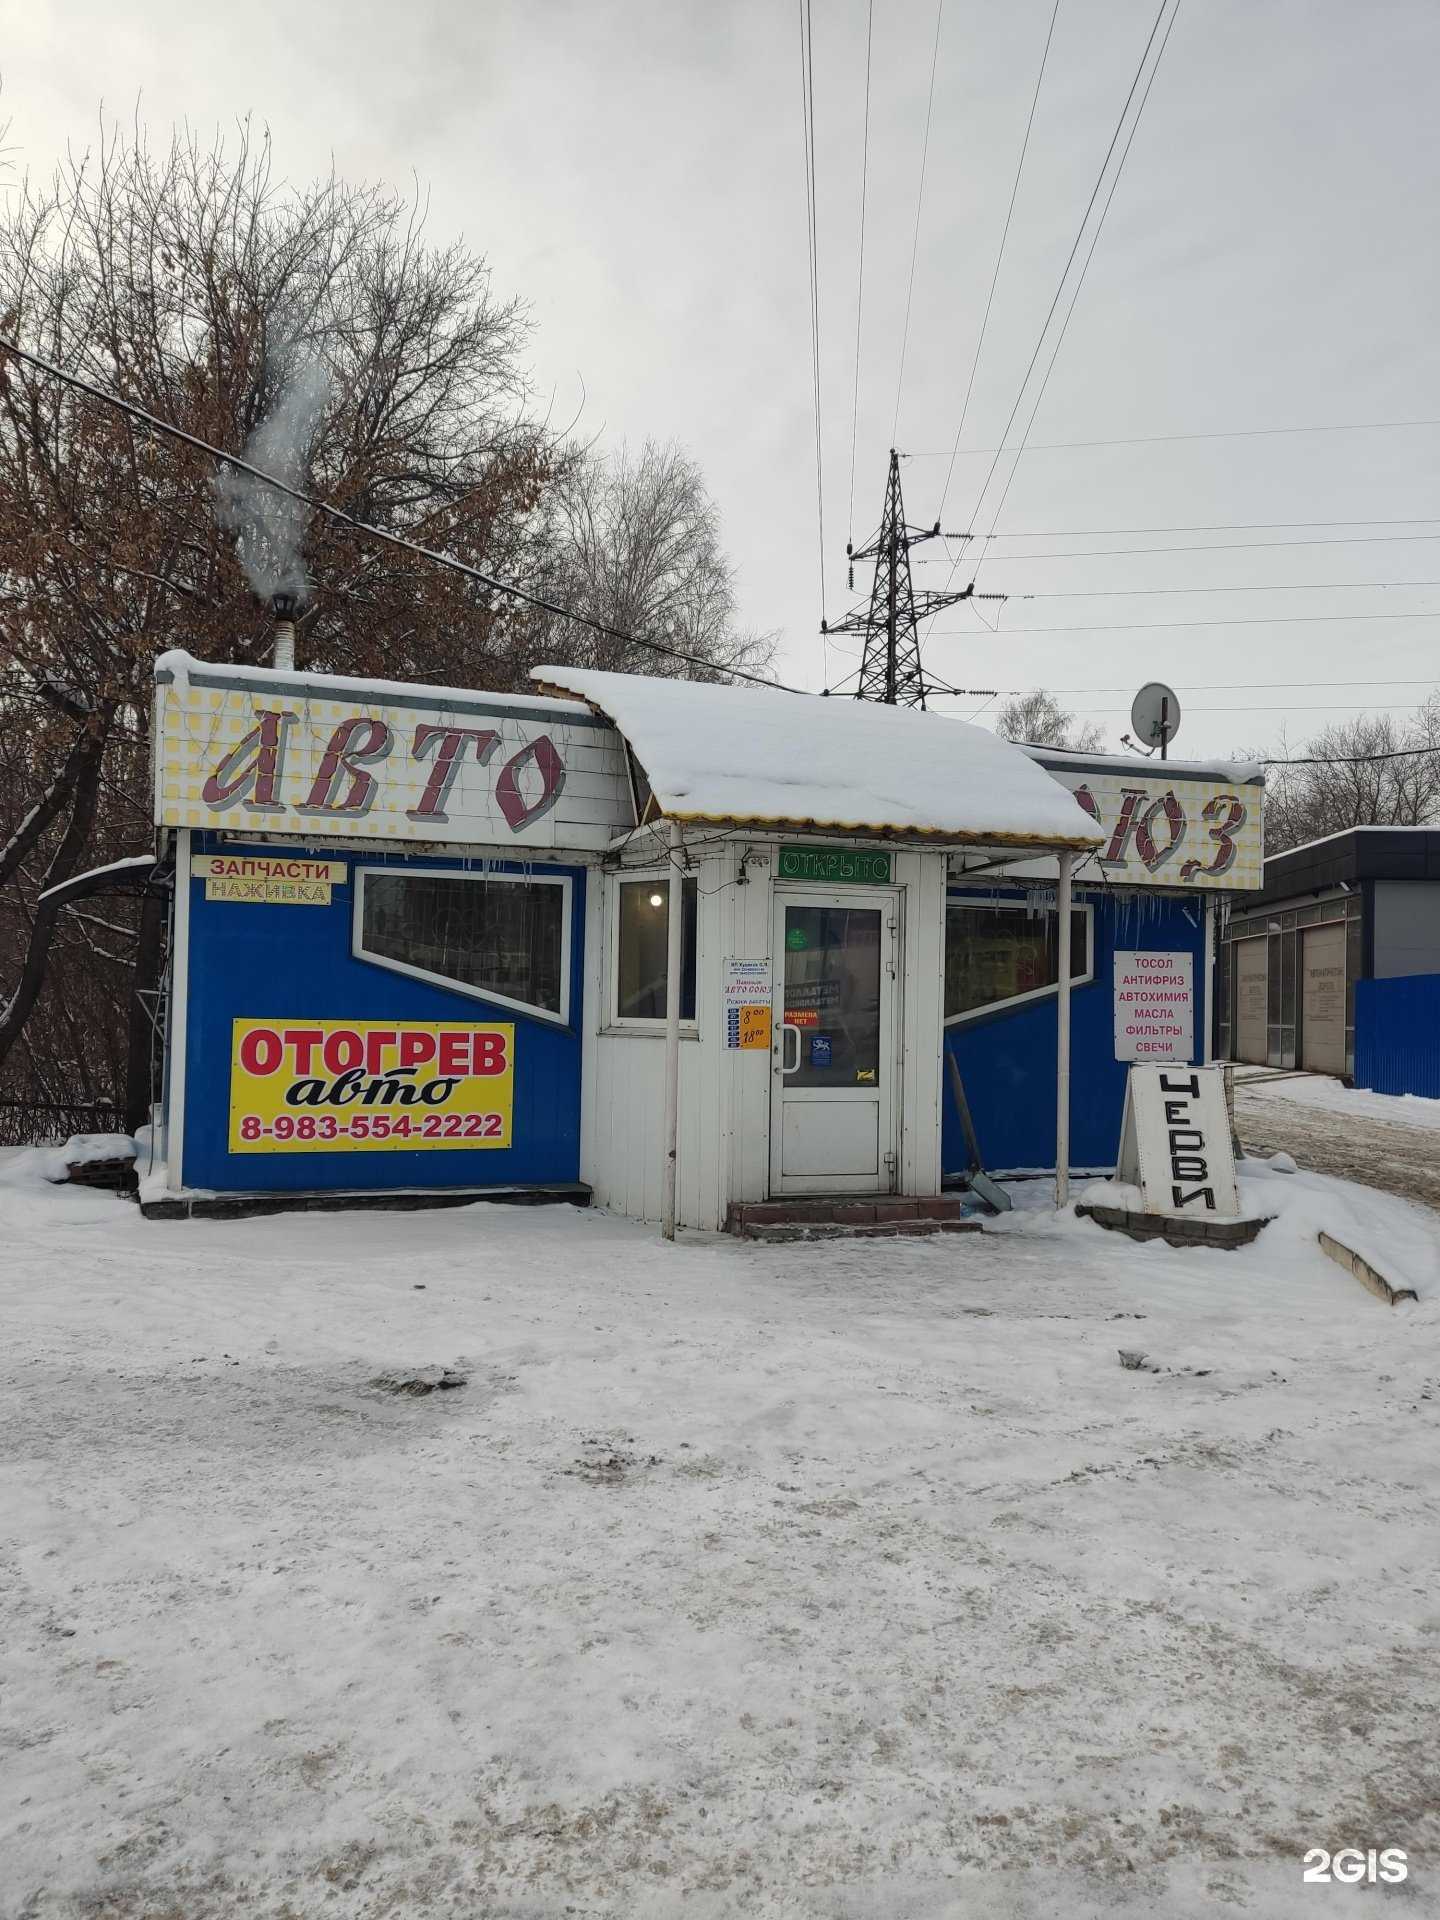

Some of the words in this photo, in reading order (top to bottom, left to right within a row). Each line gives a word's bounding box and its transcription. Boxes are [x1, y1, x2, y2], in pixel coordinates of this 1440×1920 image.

[202, 710, 566, 834] АВТО
[1074, 784, 1247, 882] ЮЗ
[210, 859, 330, 880] ЗАПЧАСТИ
[783, 852, 889, 879] ОТКРЫТО
[211, 880, 327, 901] НАЖИВКА
[1134, 958, 1173, 969] ТОСОЛ
[1123, 975, 1185, 986] АНТИФРИЗ
[1119, 992, 1189, 1002] АВТОХИМИЯ
[1134, 1009, 1174, 1019] МАСЛА
[1126, 1025, 1182, 1036] ФИЛЬТРЫ
[240, 1029, 507, 1076] ОТОГРЕВ
[1136, 1042, 1173, 1052] СВЕЧИ
[285, 1068, 462, 1106] авто
[240, 1114, 503, 1140] 8-983-554-2222
[1159, 1074, 1216, 1210] ЧЕРВИ
